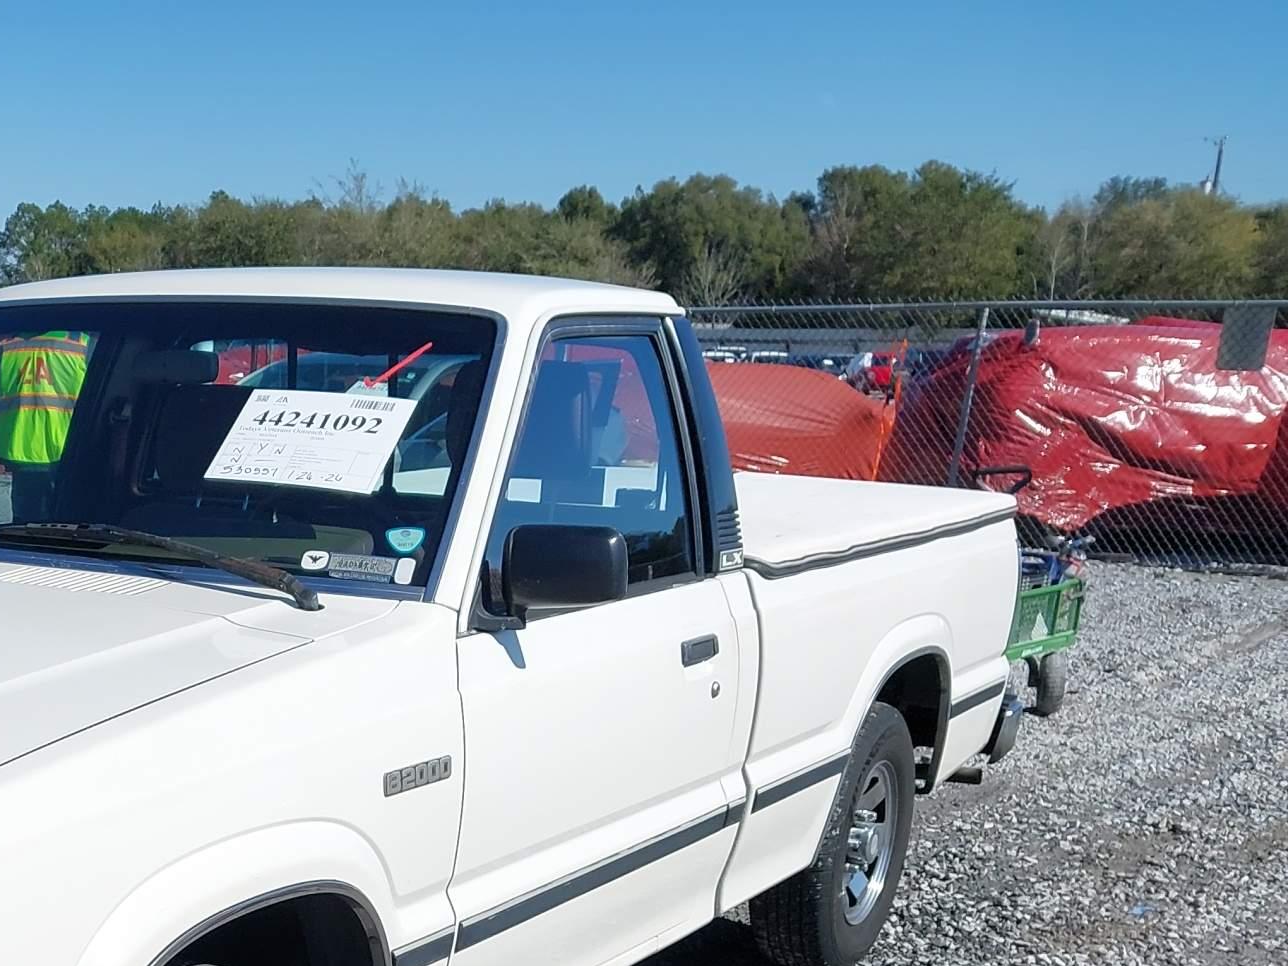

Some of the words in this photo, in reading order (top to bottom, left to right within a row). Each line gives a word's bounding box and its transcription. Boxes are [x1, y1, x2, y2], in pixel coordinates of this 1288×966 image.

[253, 409, 383, 434] 44241092
[722, 551, 743, 568] LX
[386, 756, 451, 796] B2000
